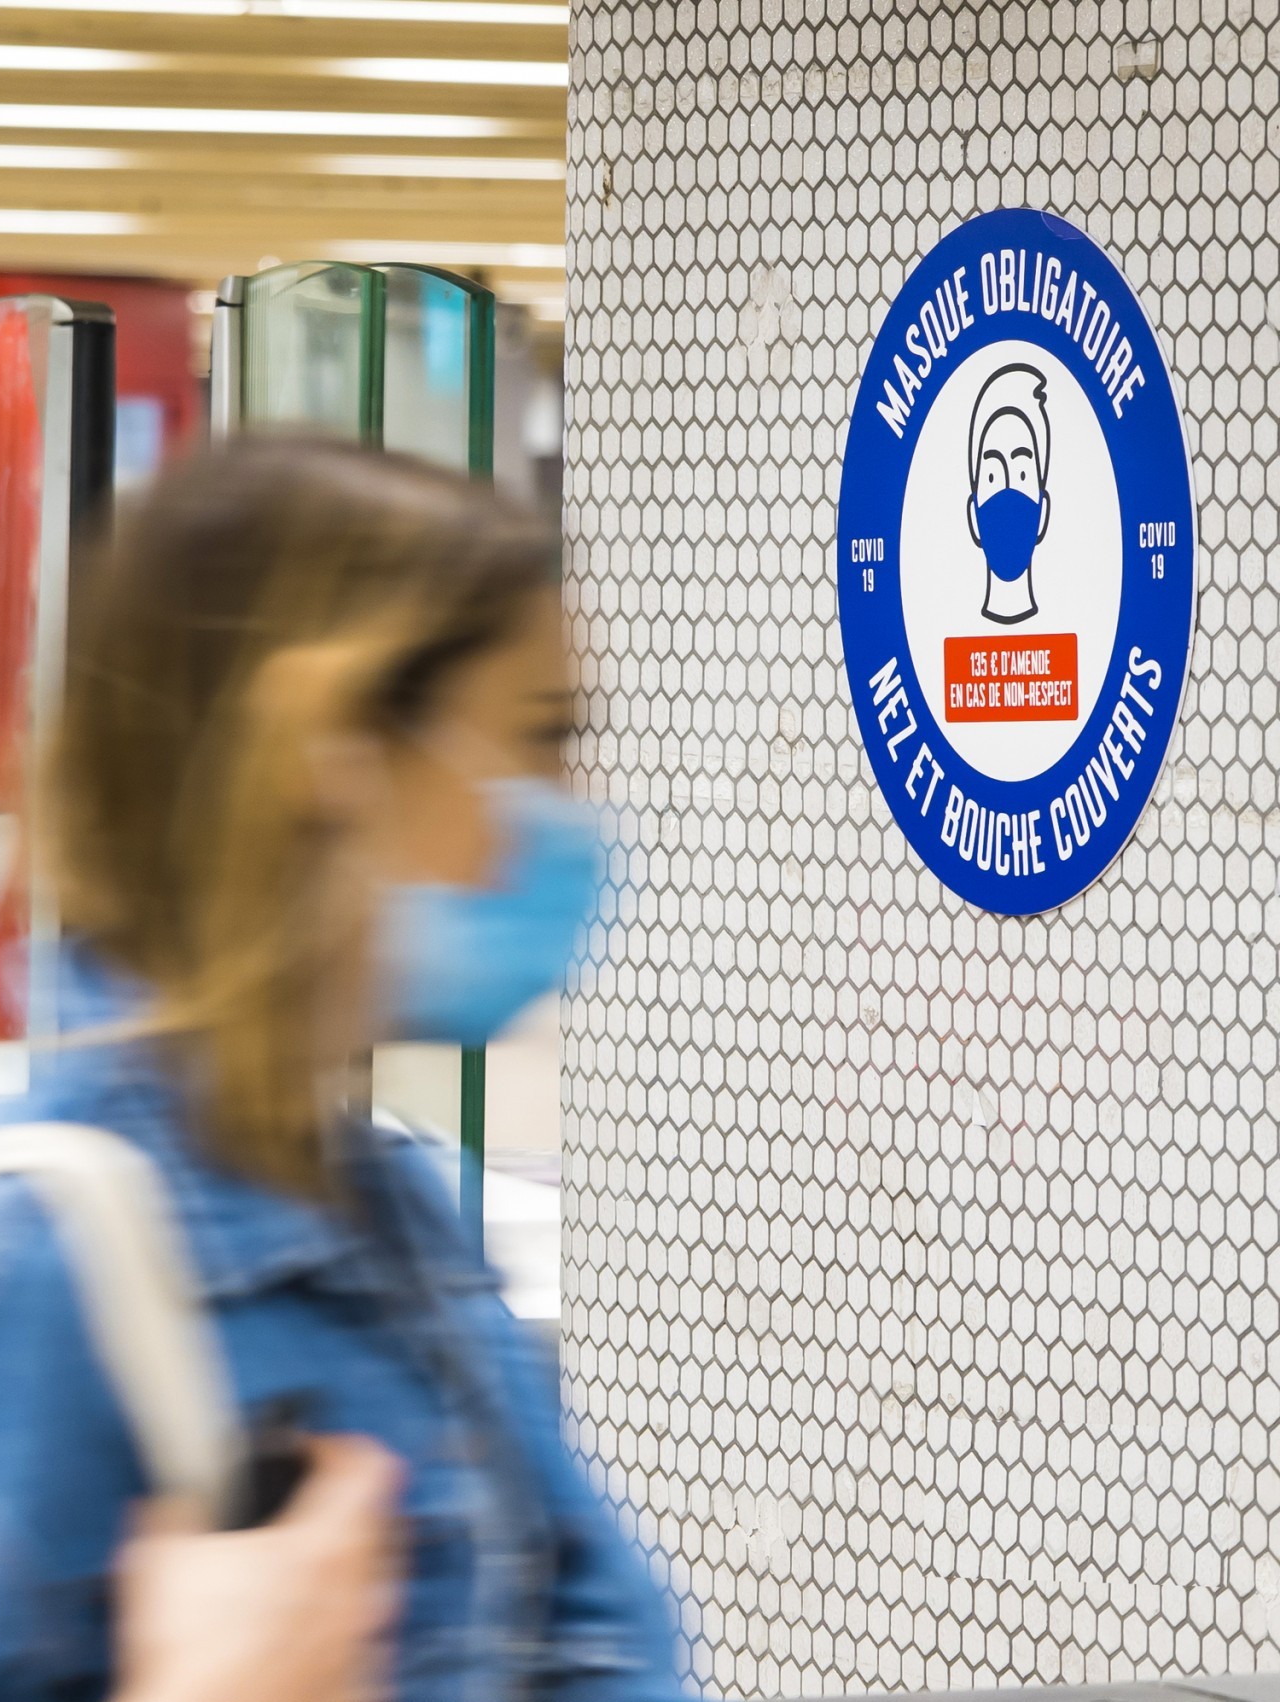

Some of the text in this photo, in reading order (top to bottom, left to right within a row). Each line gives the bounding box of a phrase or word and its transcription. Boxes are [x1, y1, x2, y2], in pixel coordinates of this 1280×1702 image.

[876, 248, 1146, 439] MASQUE OBLIGATOIRE
[1138, 521, 1176, 549] COVID
[851, 537, 884, 563] COVID
[862, 568, 874, 592] 19
[1151, 553, 1165, 580] 19
[969, 649, 1051, 677] 135 € D'AMENDE
[949, 680, 1073, 708] EN CAS DE NON-RESPECT
[868, 646, 1162, 877] NEZ ET BOUCHE COUVERTS
